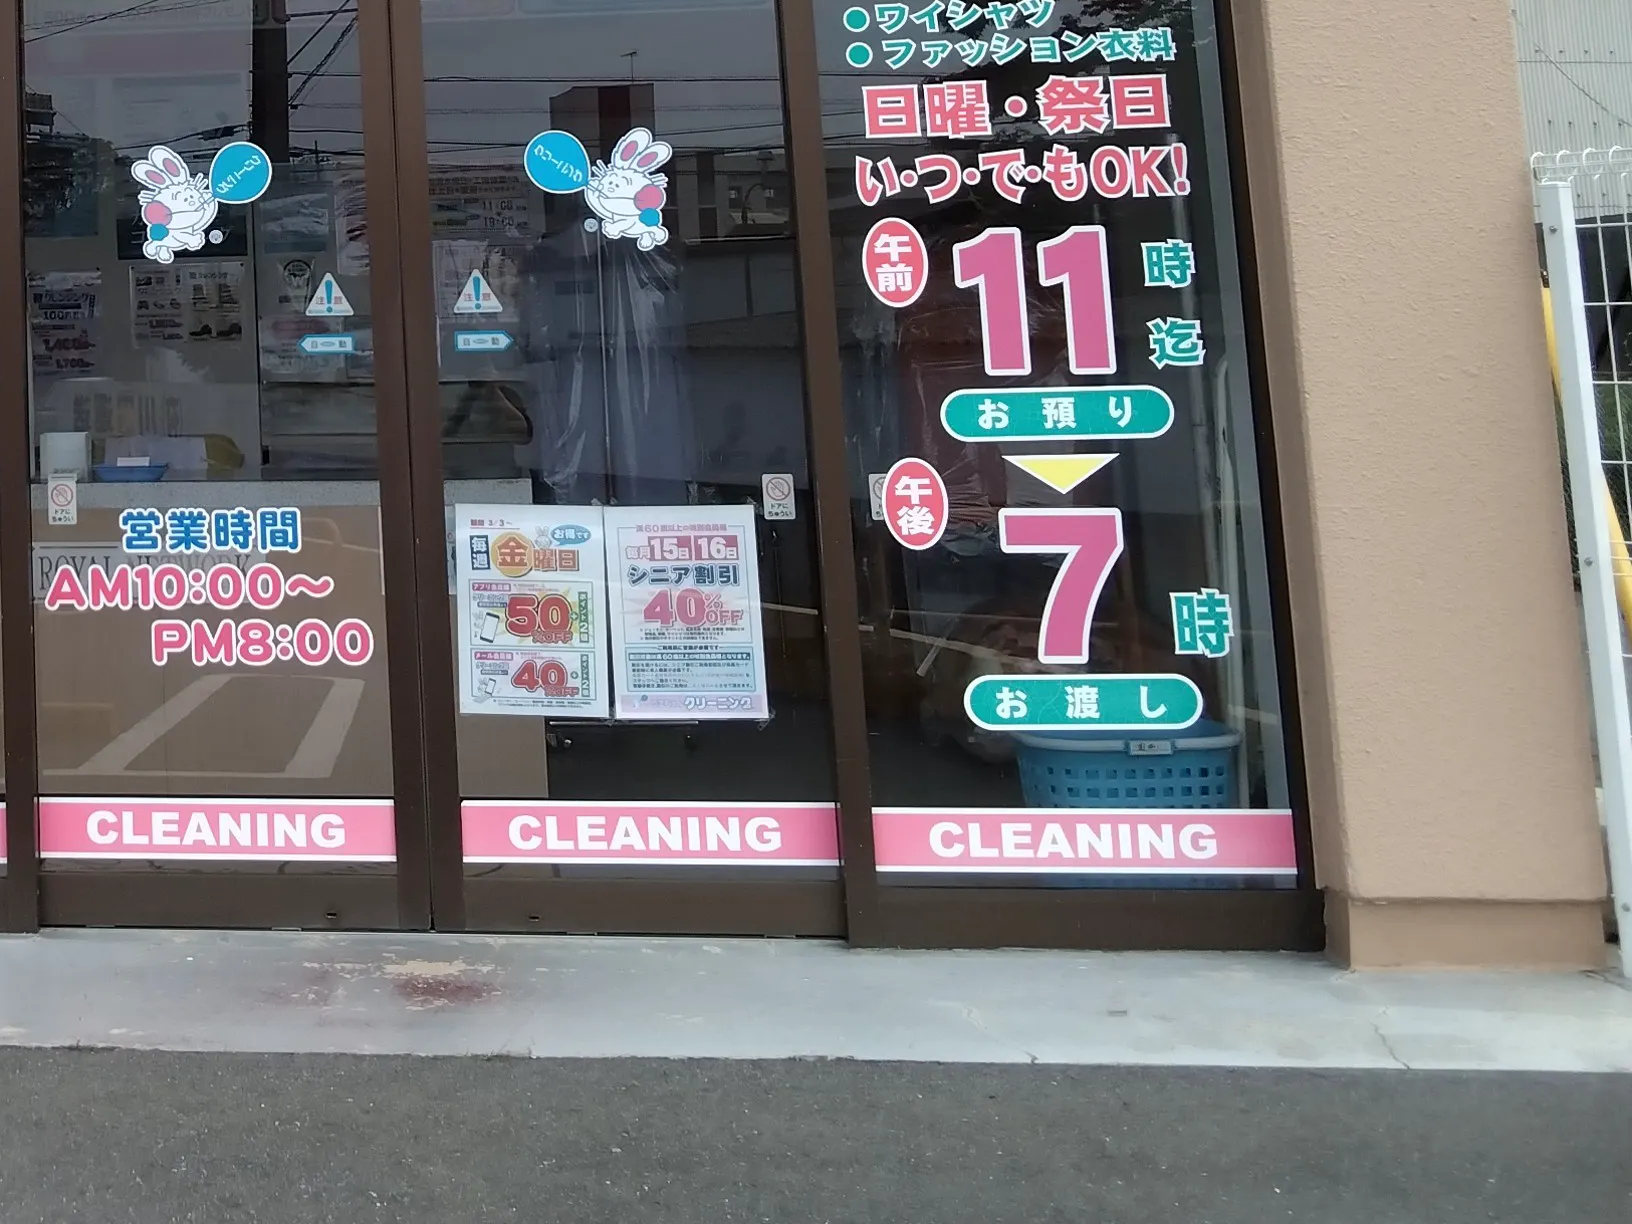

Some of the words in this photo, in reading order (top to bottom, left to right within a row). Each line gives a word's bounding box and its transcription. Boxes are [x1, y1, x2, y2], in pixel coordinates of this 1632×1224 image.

[881, 28, 1176, 69] ファッション衣料
[861, 74, 1171, 139] 日曜・祭日
[873, 232, 914, 292] 午前
[952, 224, 1118, 376] 11
[977, 396, 1133, 430] お預り
[120, 506, 302, 553] 営業時間
[650, 537, 690, 561] 15日
[697, 536, 738, 560] 16日
[471, 536, 489, 569] 毎週
[495, 534, 580, 572] 金曜日
[893, 475, 936, 536] 午後
[998, 508, 1125, 665] 7
[1169, 587, 1235, 659] 時
[628, 563, 740, 587] シニア割引
[505, 593, 573, 637] 50
[643, 587, 708, 627] 40
[151, 618, 374, 667] PM8:00
[511, 660, 568, 692] 40
[684, 696, 753, 710] クリーニング
[994, 685, 1168, 720] お渡し
[86, 809, 347, 849] CLEANING
[508, 814, 782, 853] CLEANING
[928, 820, 1220, 862] CLEANING
